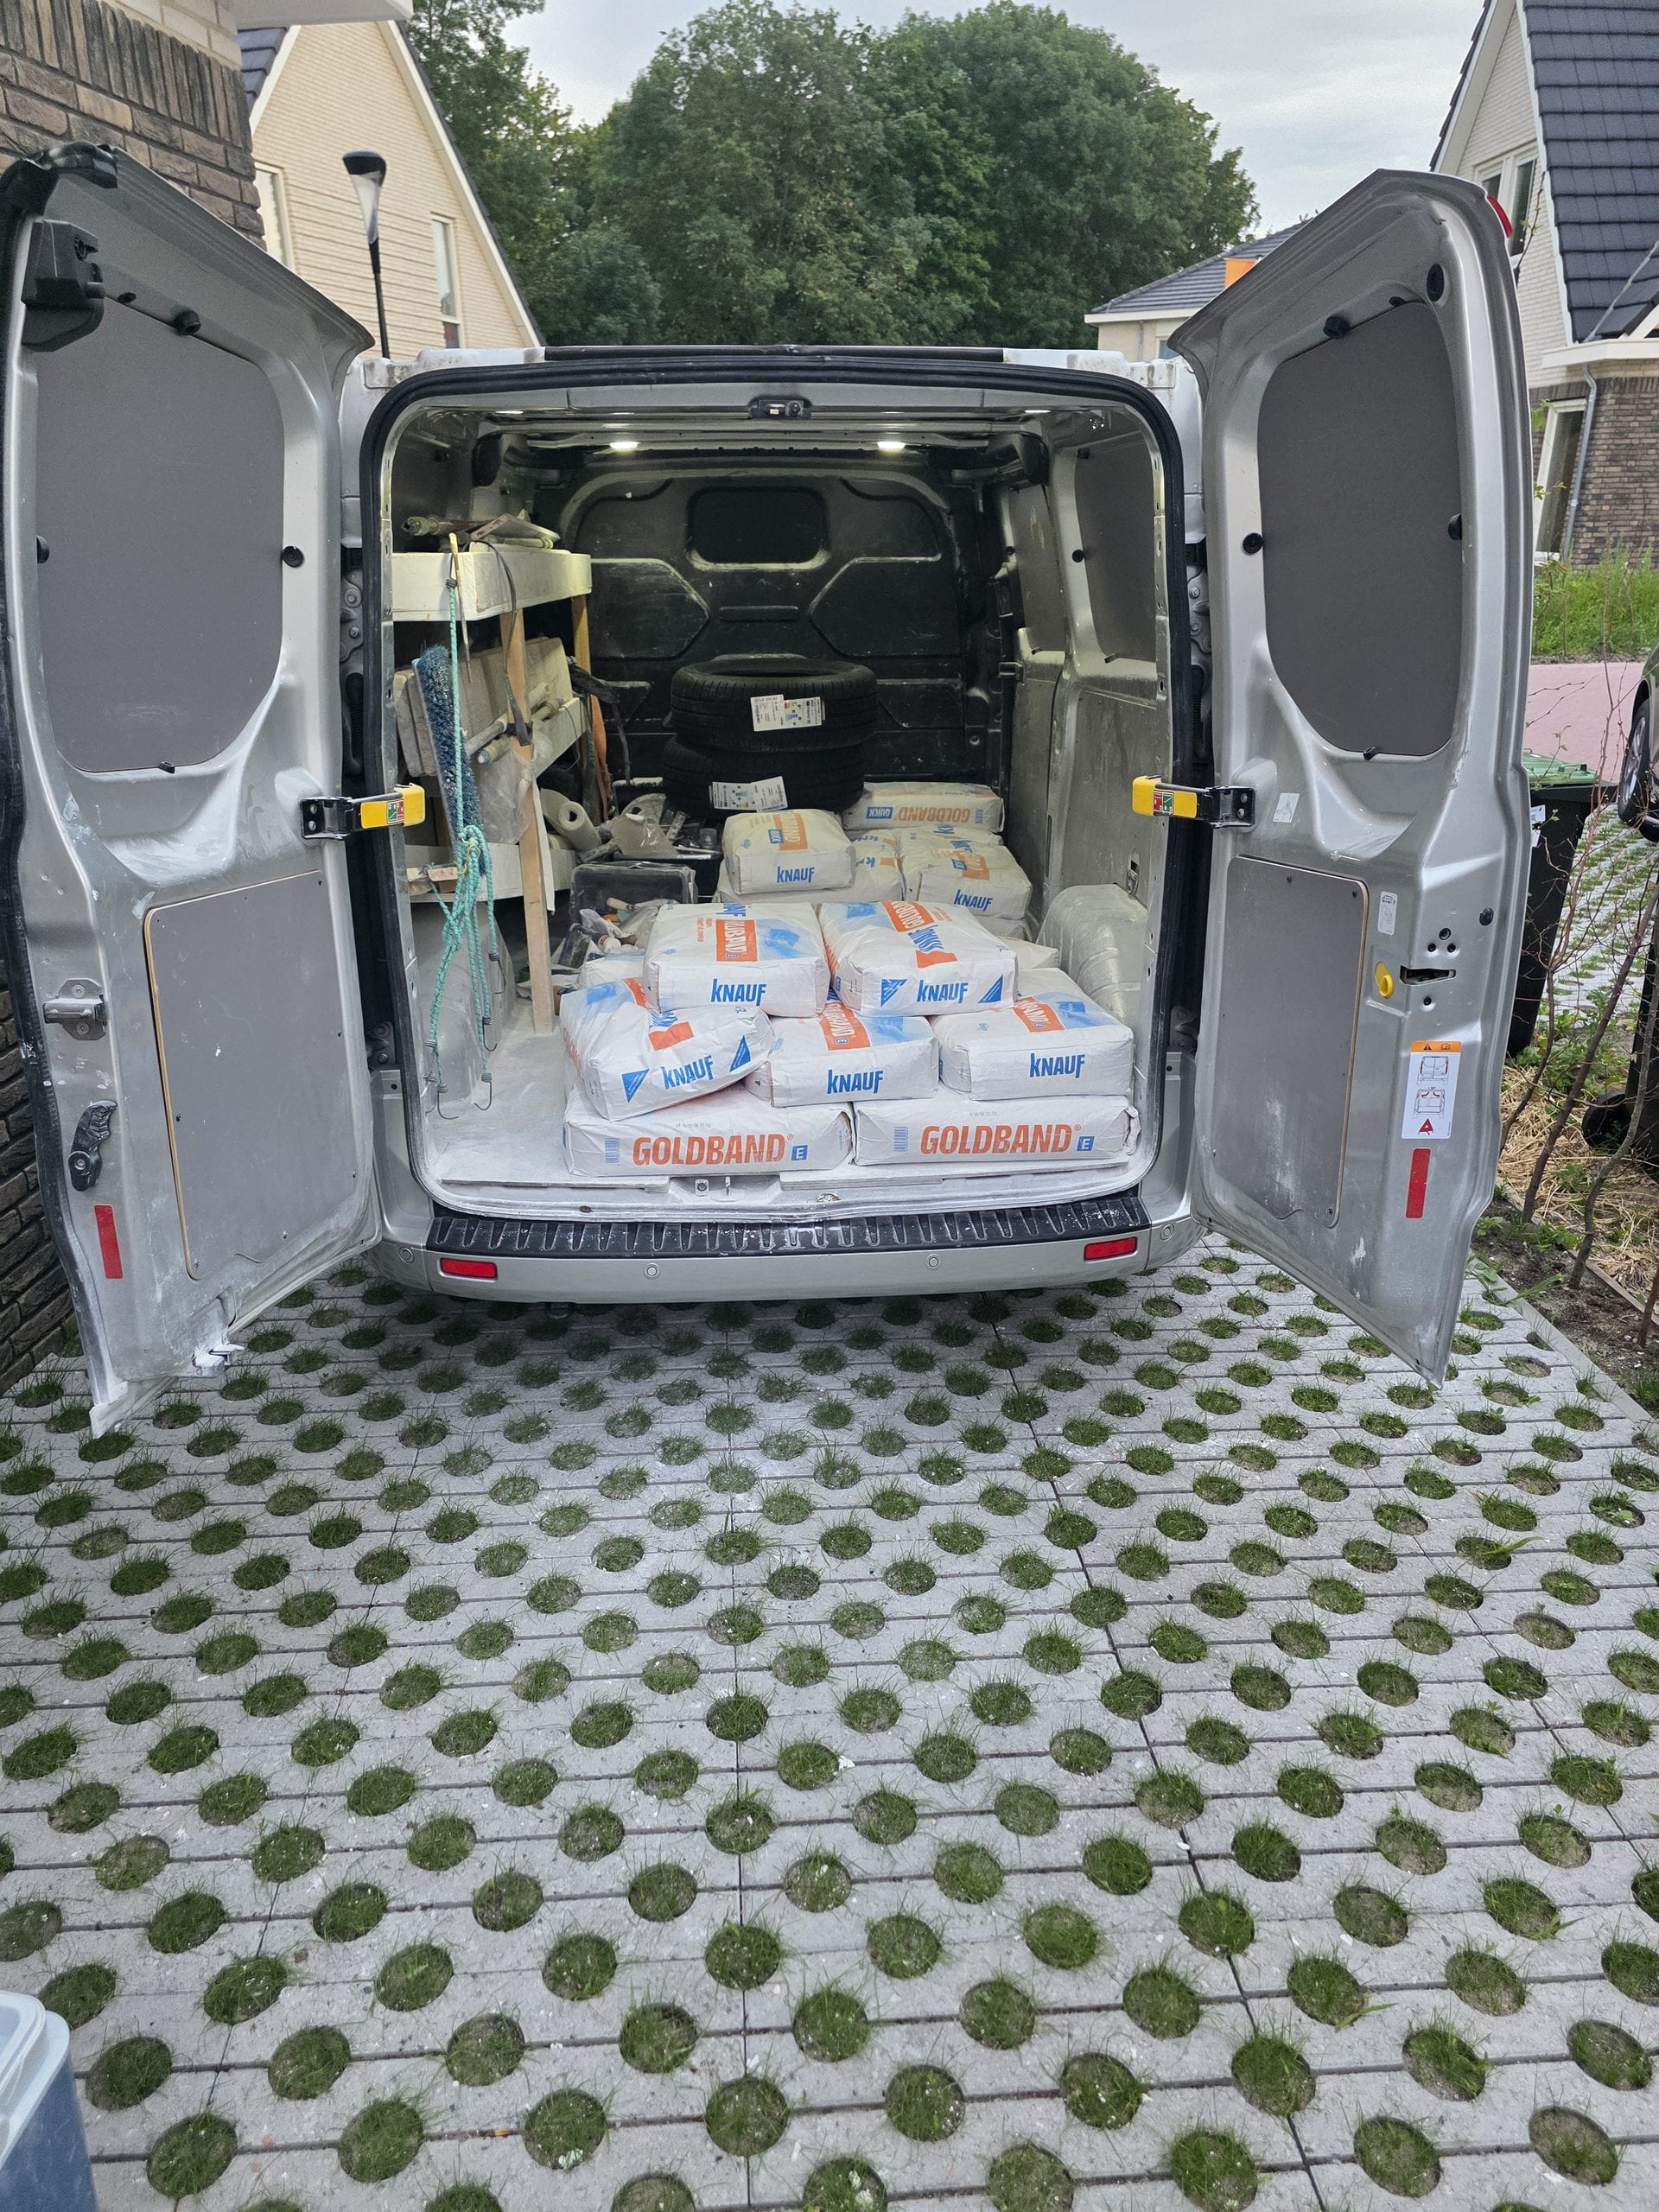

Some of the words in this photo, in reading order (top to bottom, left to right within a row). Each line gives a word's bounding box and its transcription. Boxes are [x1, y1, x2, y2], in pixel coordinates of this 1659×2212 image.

[868, 807, 891, 817] QUICK
[898, 806, 971, 823] GOLDBAND
[776, 866, 815, 883] KNAUF
[953, 889, 994, 912] KNAUF
[710, 978, 766, 1007] KNAUF
[917, 979, 968, 1004] KNAUF
[661, 1054, 714, 1090] KNAUF
[1029, 1052, 1085, 1078] KNAUF
[827, 1069, 884, 1094] KNAUF
[632, 1134, 785, 1166] GOLDBAND
[919, 1124, 1071, 1155] GOLDBAND
